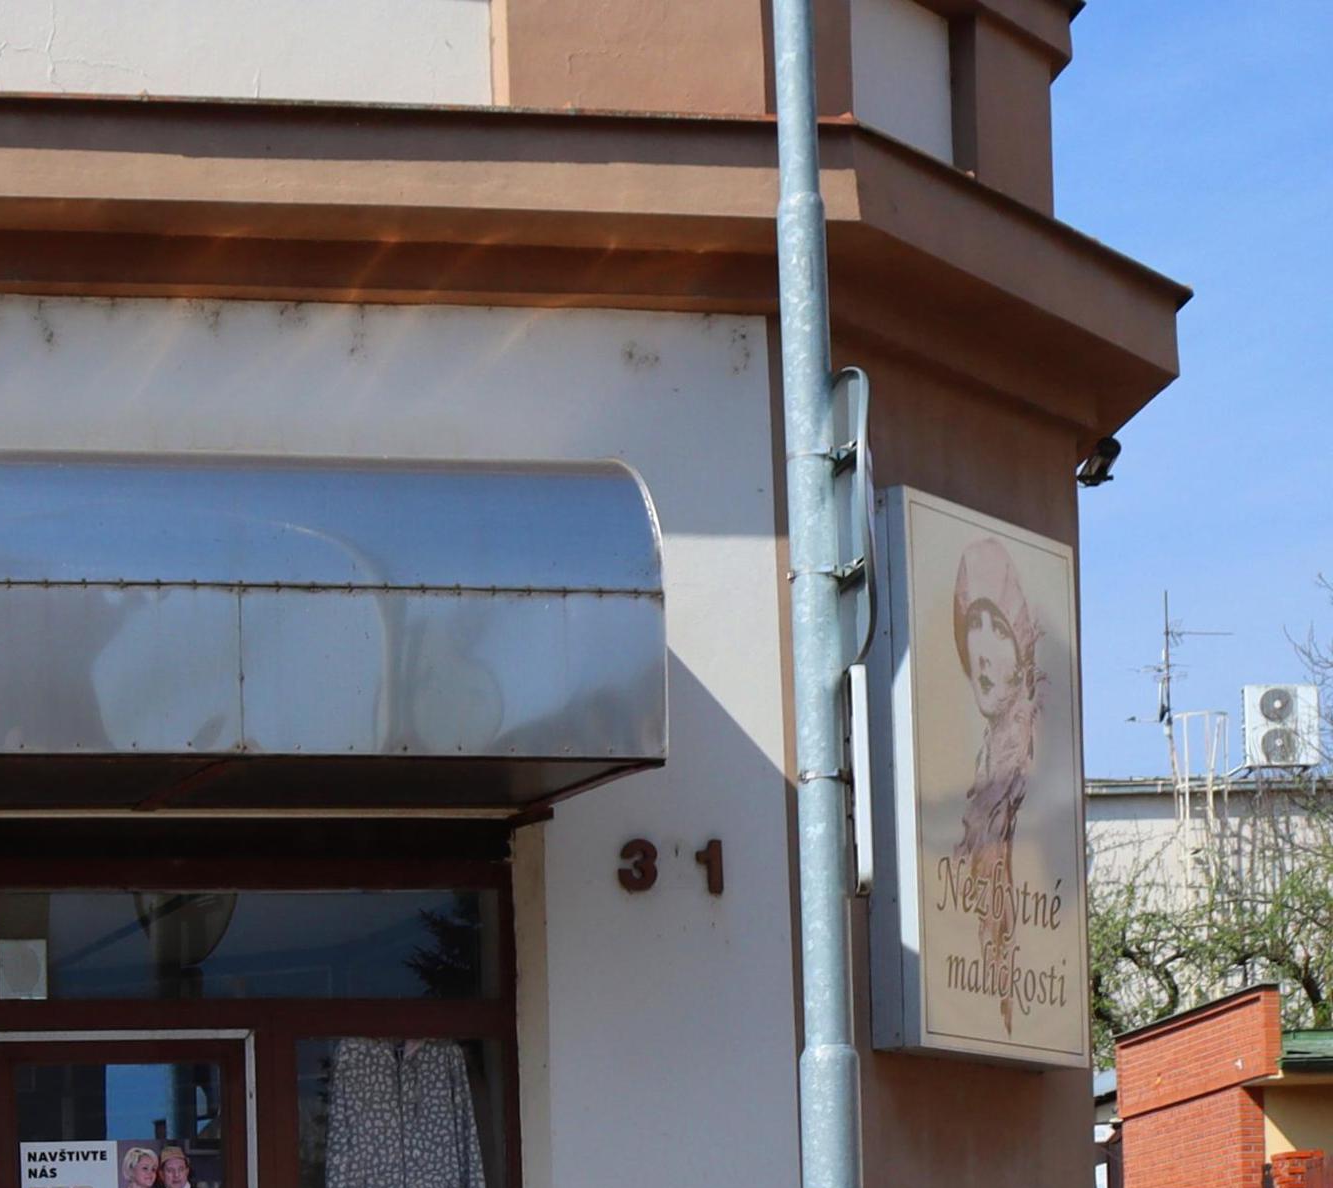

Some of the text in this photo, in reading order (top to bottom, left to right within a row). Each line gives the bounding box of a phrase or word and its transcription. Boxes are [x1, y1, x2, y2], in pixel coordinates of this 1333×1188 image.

[936, 856, 1062, 942] Nezbytné
[947, 940, 1068, 1016] maličkosti
[27, 1149, 108, 1162] NAVŠTIVTE
[28, 1165, 58, 1179] NÁS
